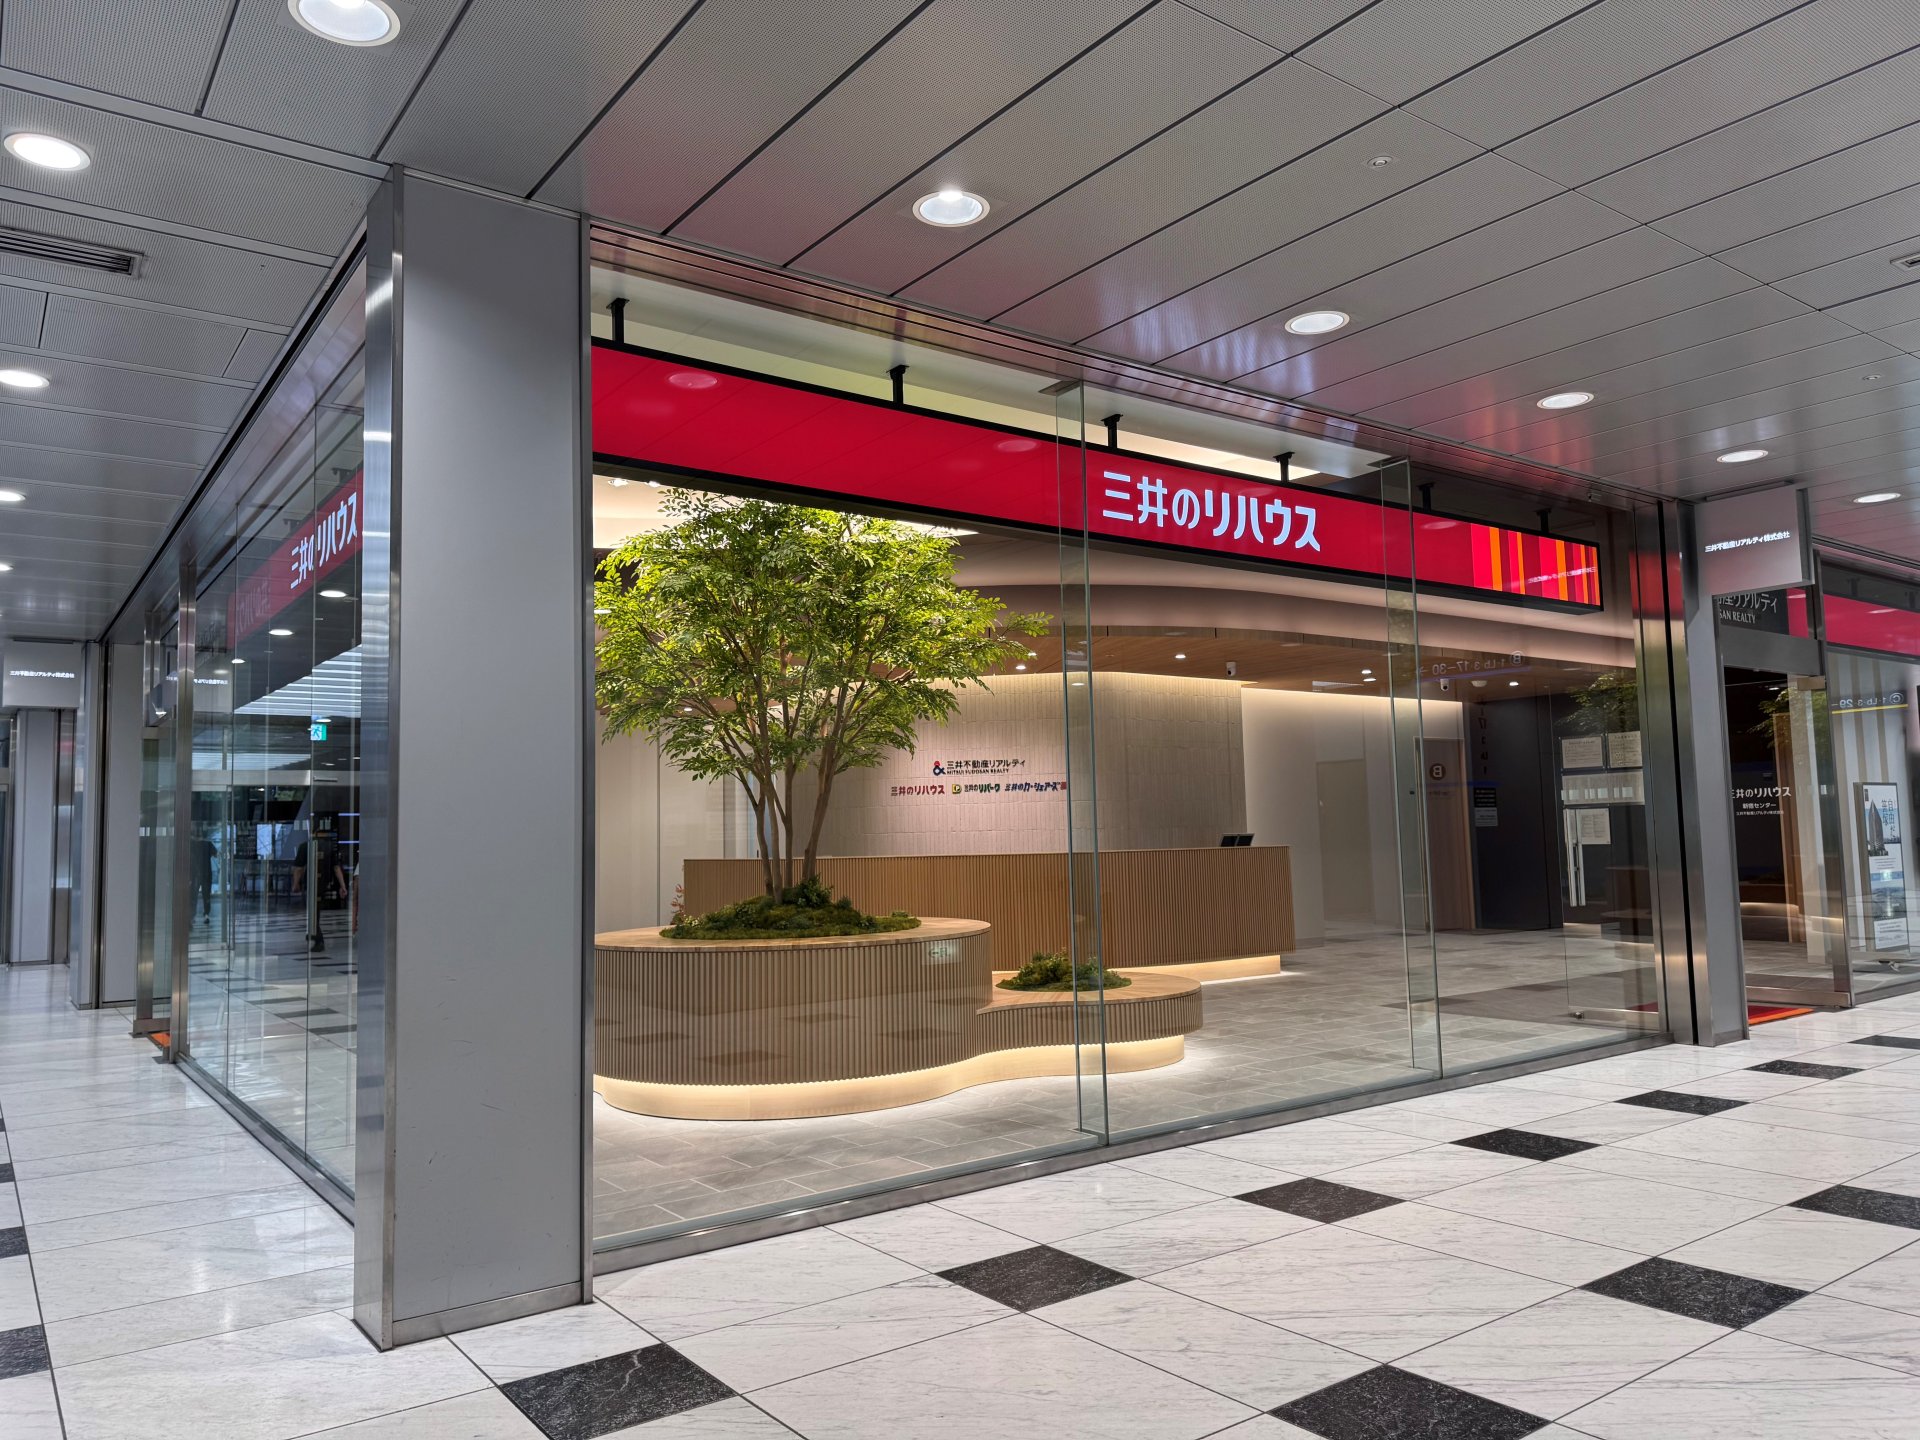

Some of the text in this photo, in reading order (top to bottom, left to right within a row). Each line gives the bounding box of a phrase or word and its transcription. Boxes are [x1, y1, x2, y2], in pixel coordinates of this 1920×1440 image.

[1103, 471, 1321, 552] 三井のリハウス
[290, 491, 358, 590] 三井のリハウス
[1732, 611, 1756, 624] REALTY
[946, 758, 1026, 770] 三井不動産リアルティ
[890, 784, 946, 797] 三井のリハウス
[1730, 786, 1792, 799] 三井のリハウス
